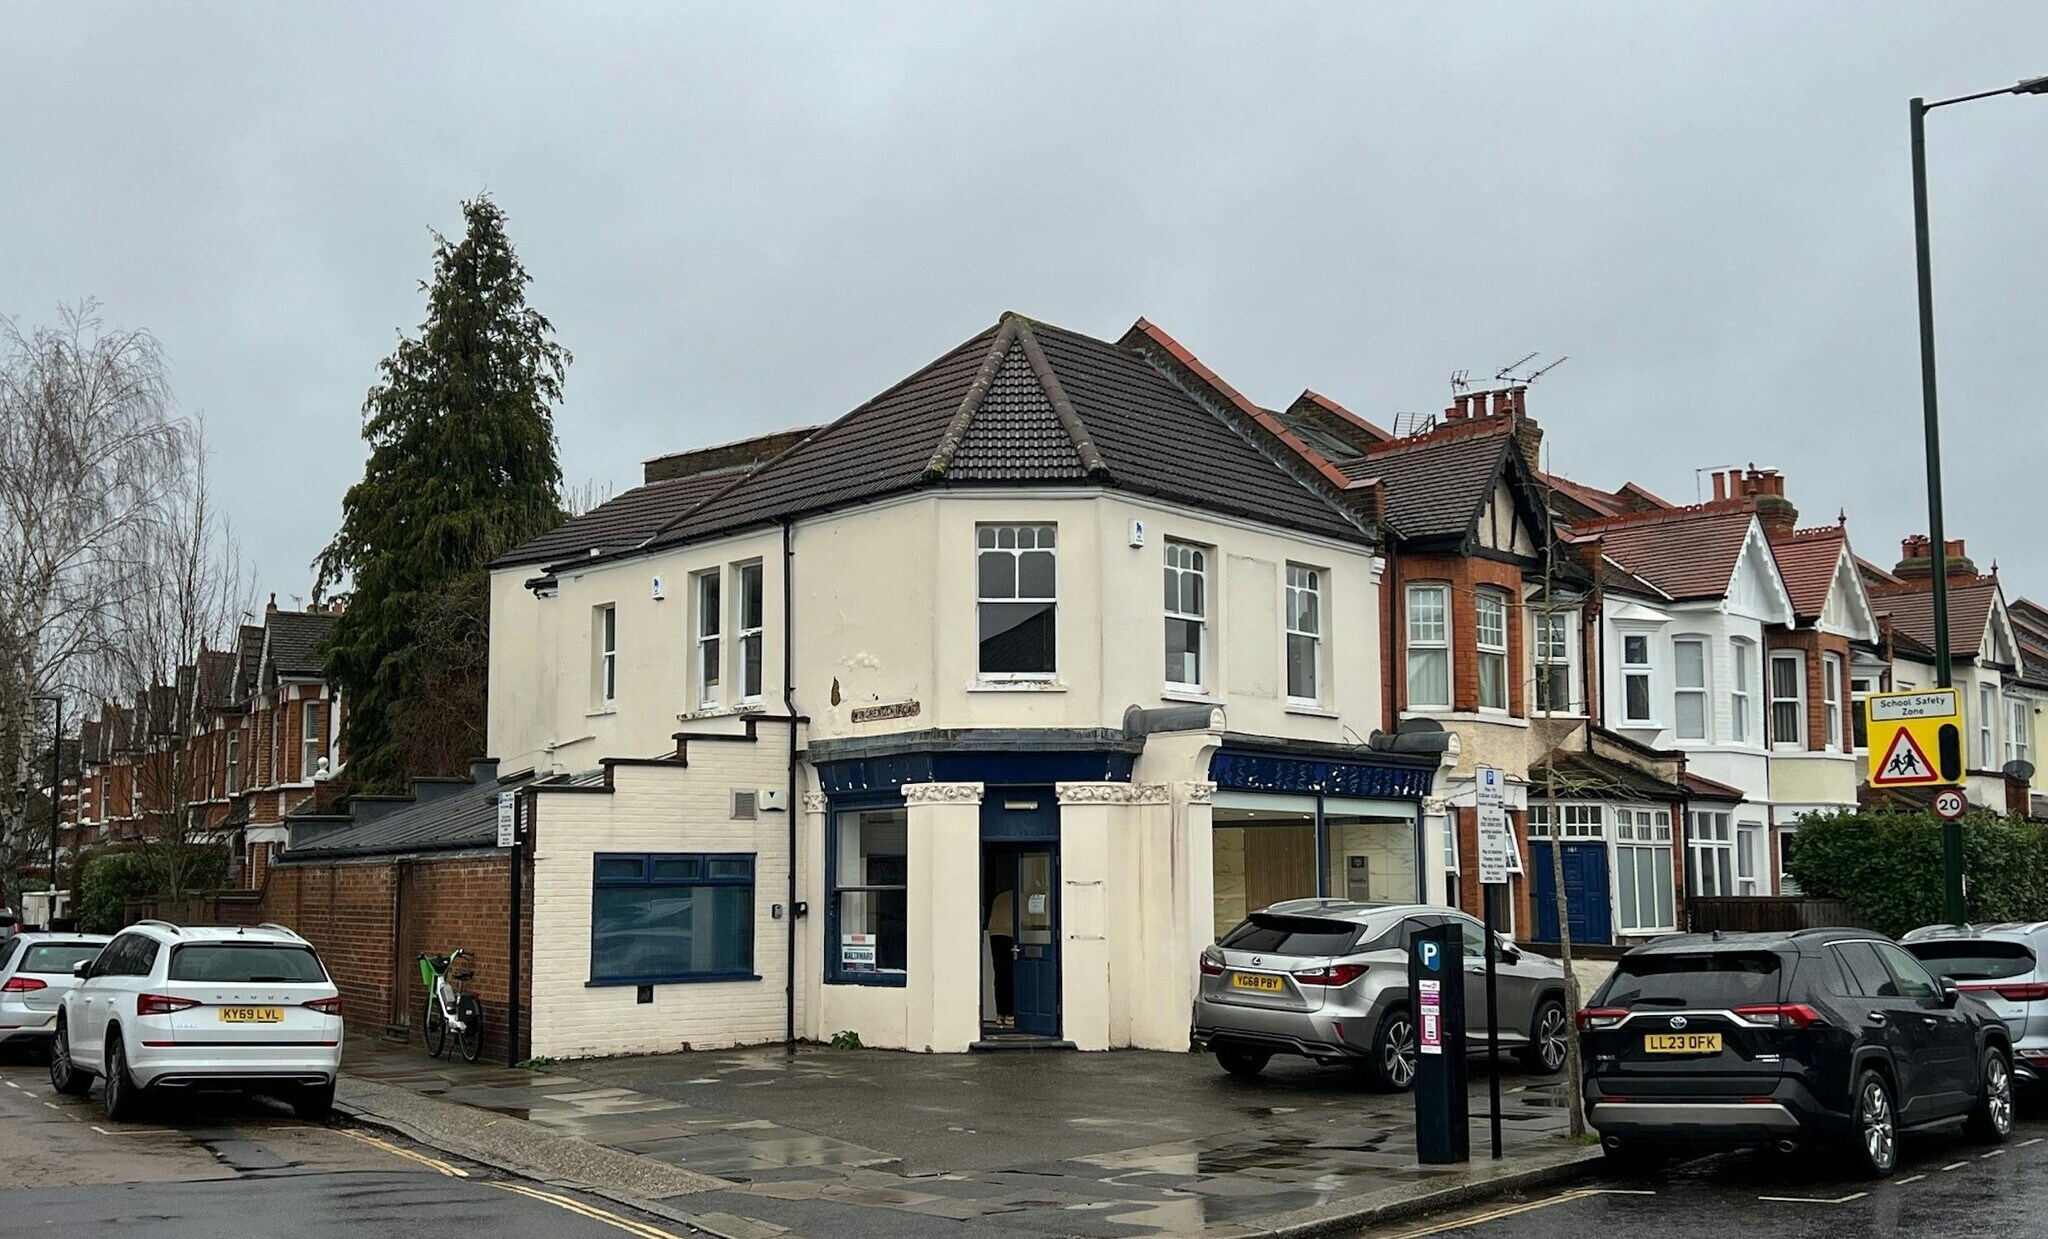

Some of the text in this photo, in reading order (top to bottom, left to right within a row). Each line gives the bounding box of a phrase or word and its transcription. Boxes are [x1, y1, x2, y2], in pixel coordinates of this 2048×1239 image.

[1880, 696, 1945, 708] School Safety
[1902, 708, 1924, 716] Zone
[1938, 798, 1960, 811] 20
[1423, 943, 1437, 966] P
[1237, 975, 1279, 988] YG68 PBY
[223, 1008, 279, 1020] KY69 LVL
[1650, 1035, 1716, 1050] LL23 OFK
